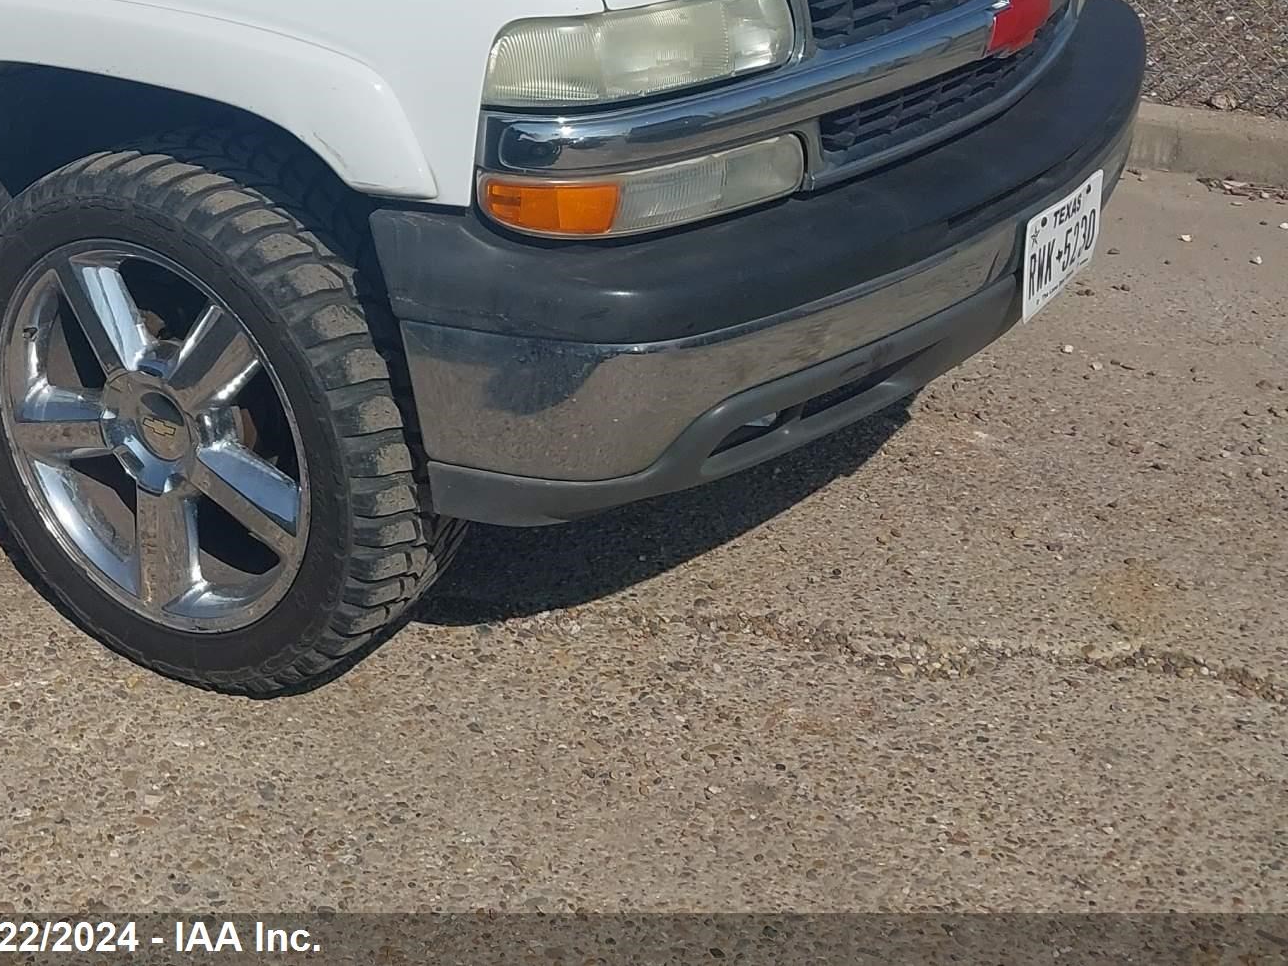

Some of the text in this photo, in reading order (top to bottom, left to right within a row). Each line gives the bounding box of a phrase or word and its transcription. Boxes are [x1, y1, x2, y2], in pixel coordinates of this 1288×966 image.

[1053, 194, 1082, 229] TEXAS
[1028, 208, 1096, 301] RWK 5230
